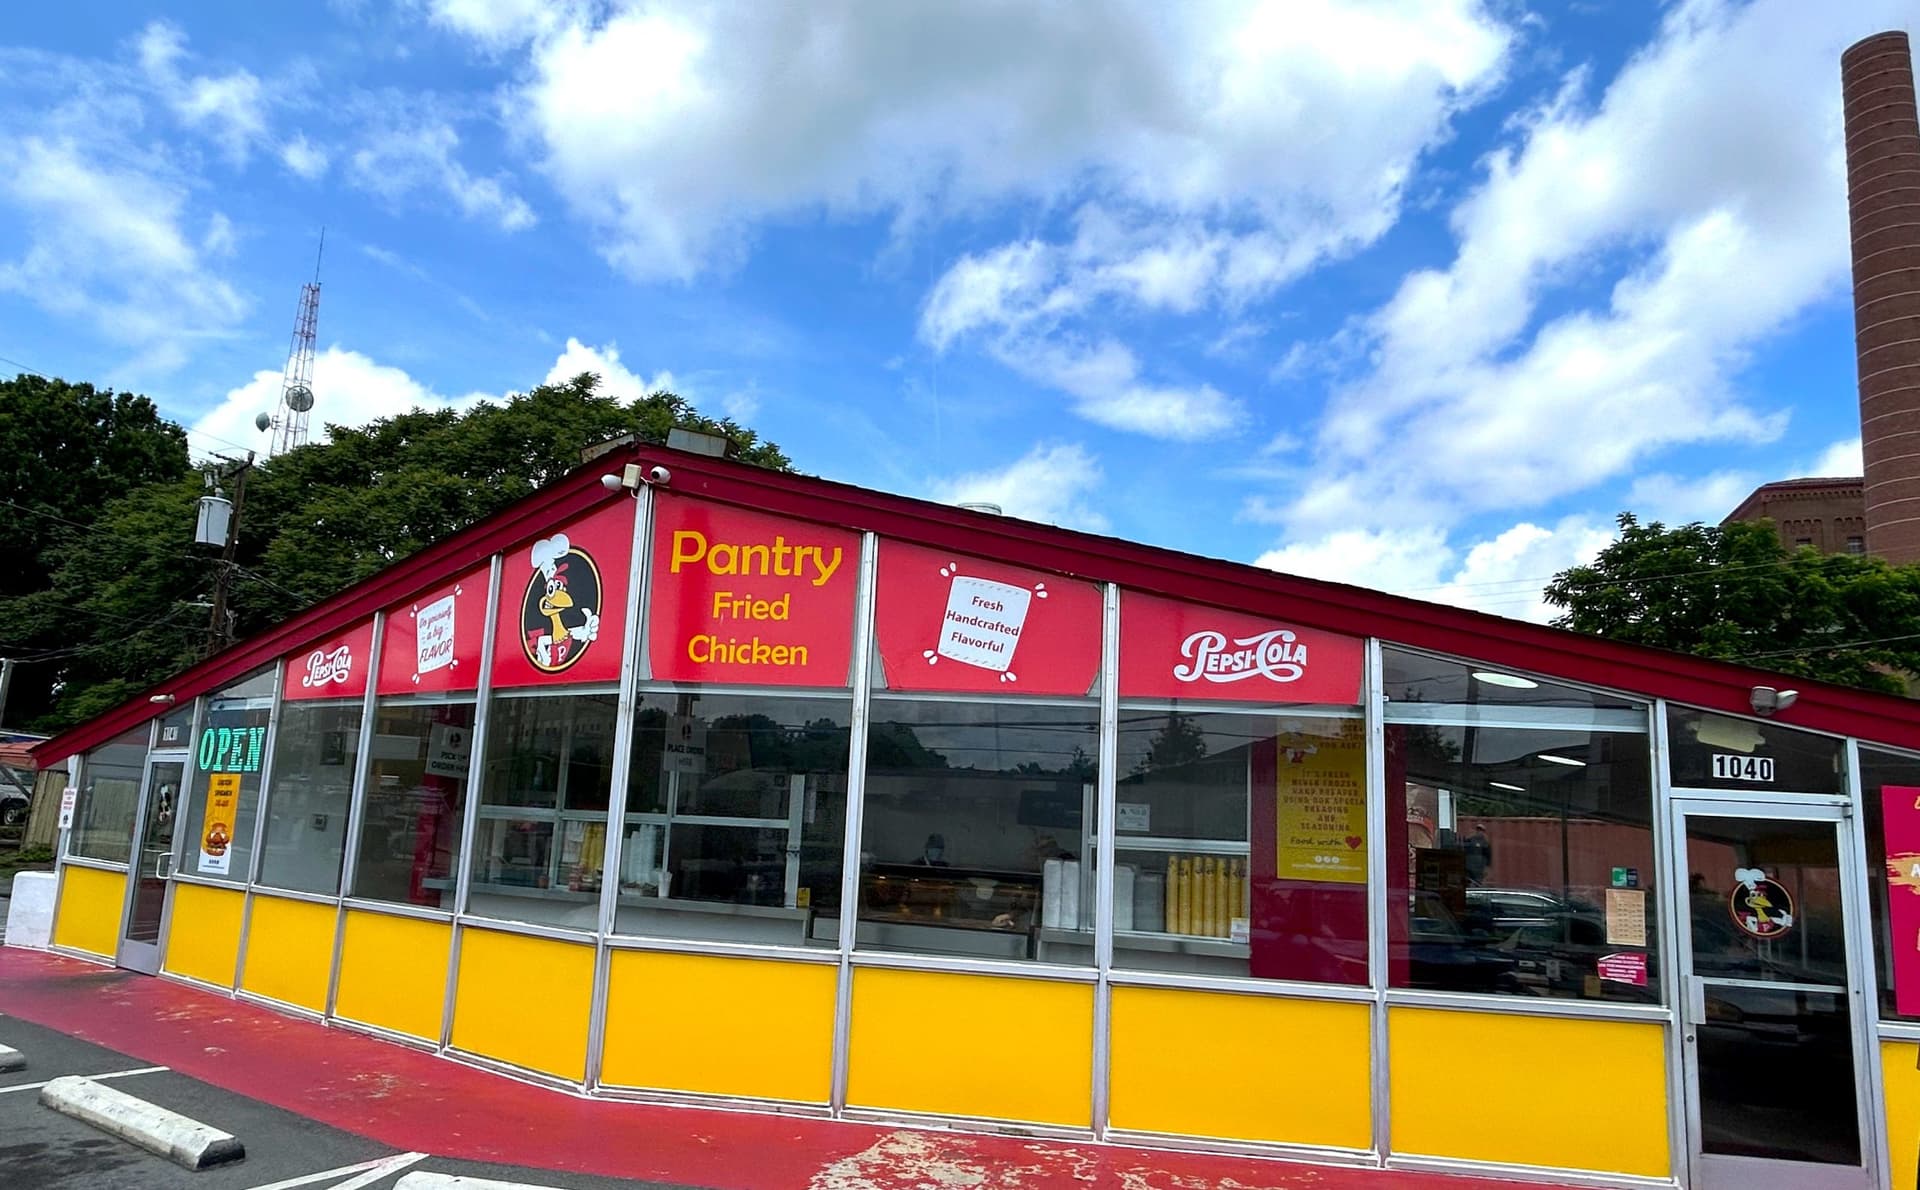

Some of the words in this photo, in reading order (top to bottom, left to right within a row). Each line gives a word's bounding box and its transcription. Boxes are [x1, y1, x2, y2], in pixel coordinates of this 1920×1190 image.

[670, 531, 842, 586] Pantry
[713, 591, 789, 620] Fried
[972, 596, 1004, 612] Fresh
[946, 610, 1020, 636] Handcrafted
[420, 639, 453, 663] FLAVOR
[558, 646, 567, 662] P
[688, 634, 808, 665] Chicken
[951, 632, 1005, 653] Flavorful
[200, 728, 265, 772] OPEN
[1716, 756, 1771, 780] 1040
